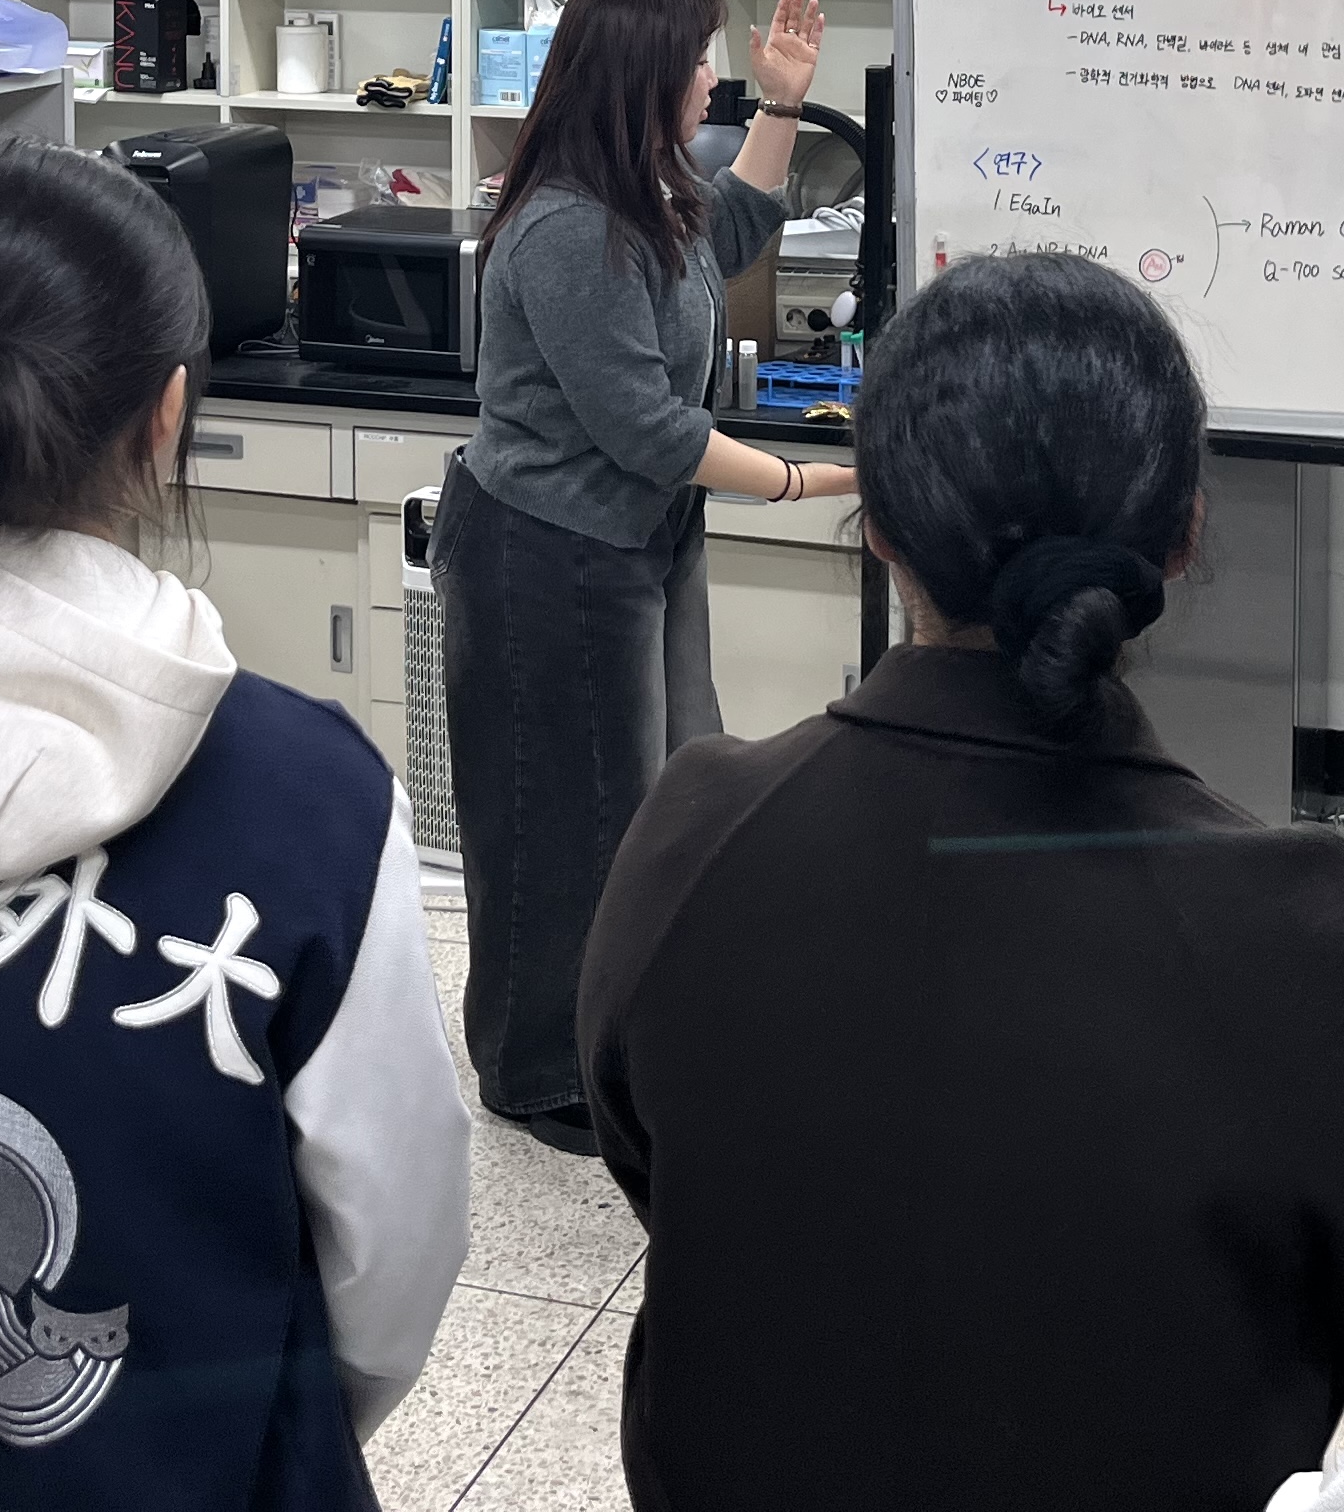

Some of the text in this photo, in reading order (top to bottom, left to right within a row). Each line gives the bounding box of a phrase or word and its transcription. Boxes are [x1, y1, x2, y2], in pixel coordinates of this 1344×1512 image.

[1071, 3, 1108, 19] 바이오
[947, 72, 986, 88] NBOE
[1233, 75, 1261, 93] DNA
[952, 91, 983, 107] 파이팅
